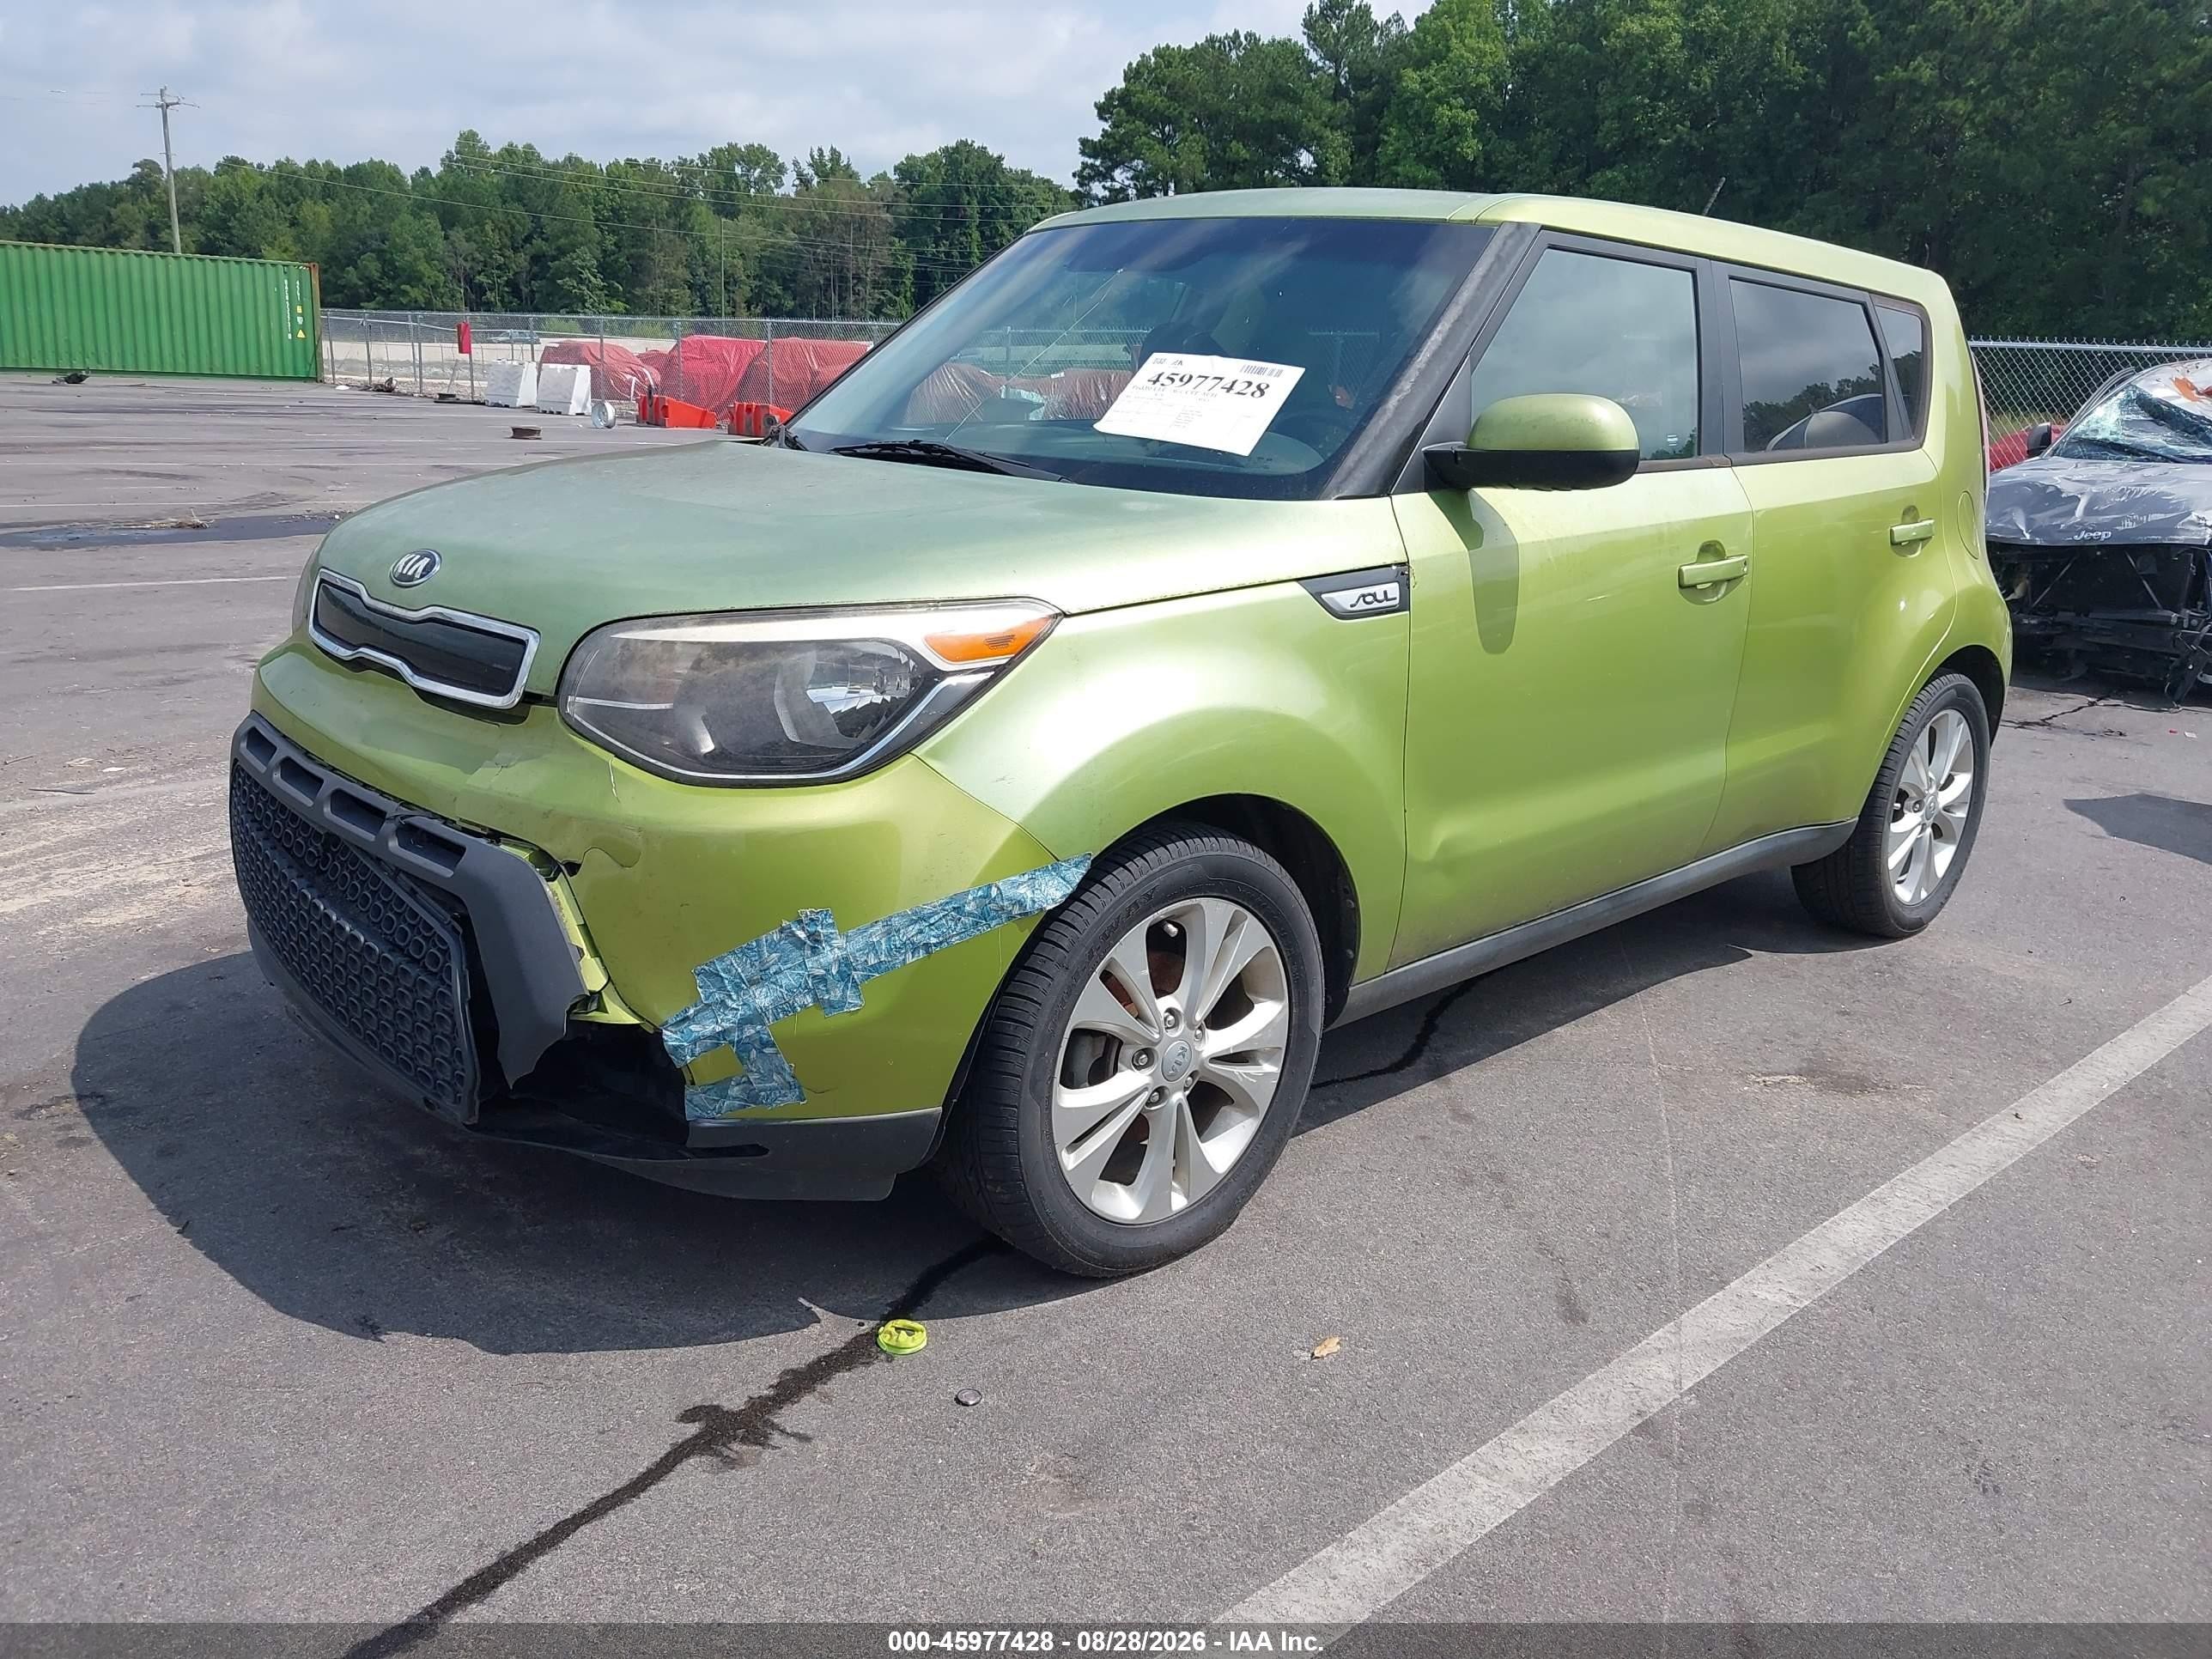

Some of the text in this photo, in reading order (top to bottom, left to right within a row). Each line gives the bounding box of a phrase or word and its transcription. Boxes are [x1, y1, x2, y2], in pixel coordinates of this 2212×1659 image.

[1147, 371, 1270, 398] 45977428
[2073, 530, 2112, 541] Jeep
[393, 553, 431, 579] KIA
